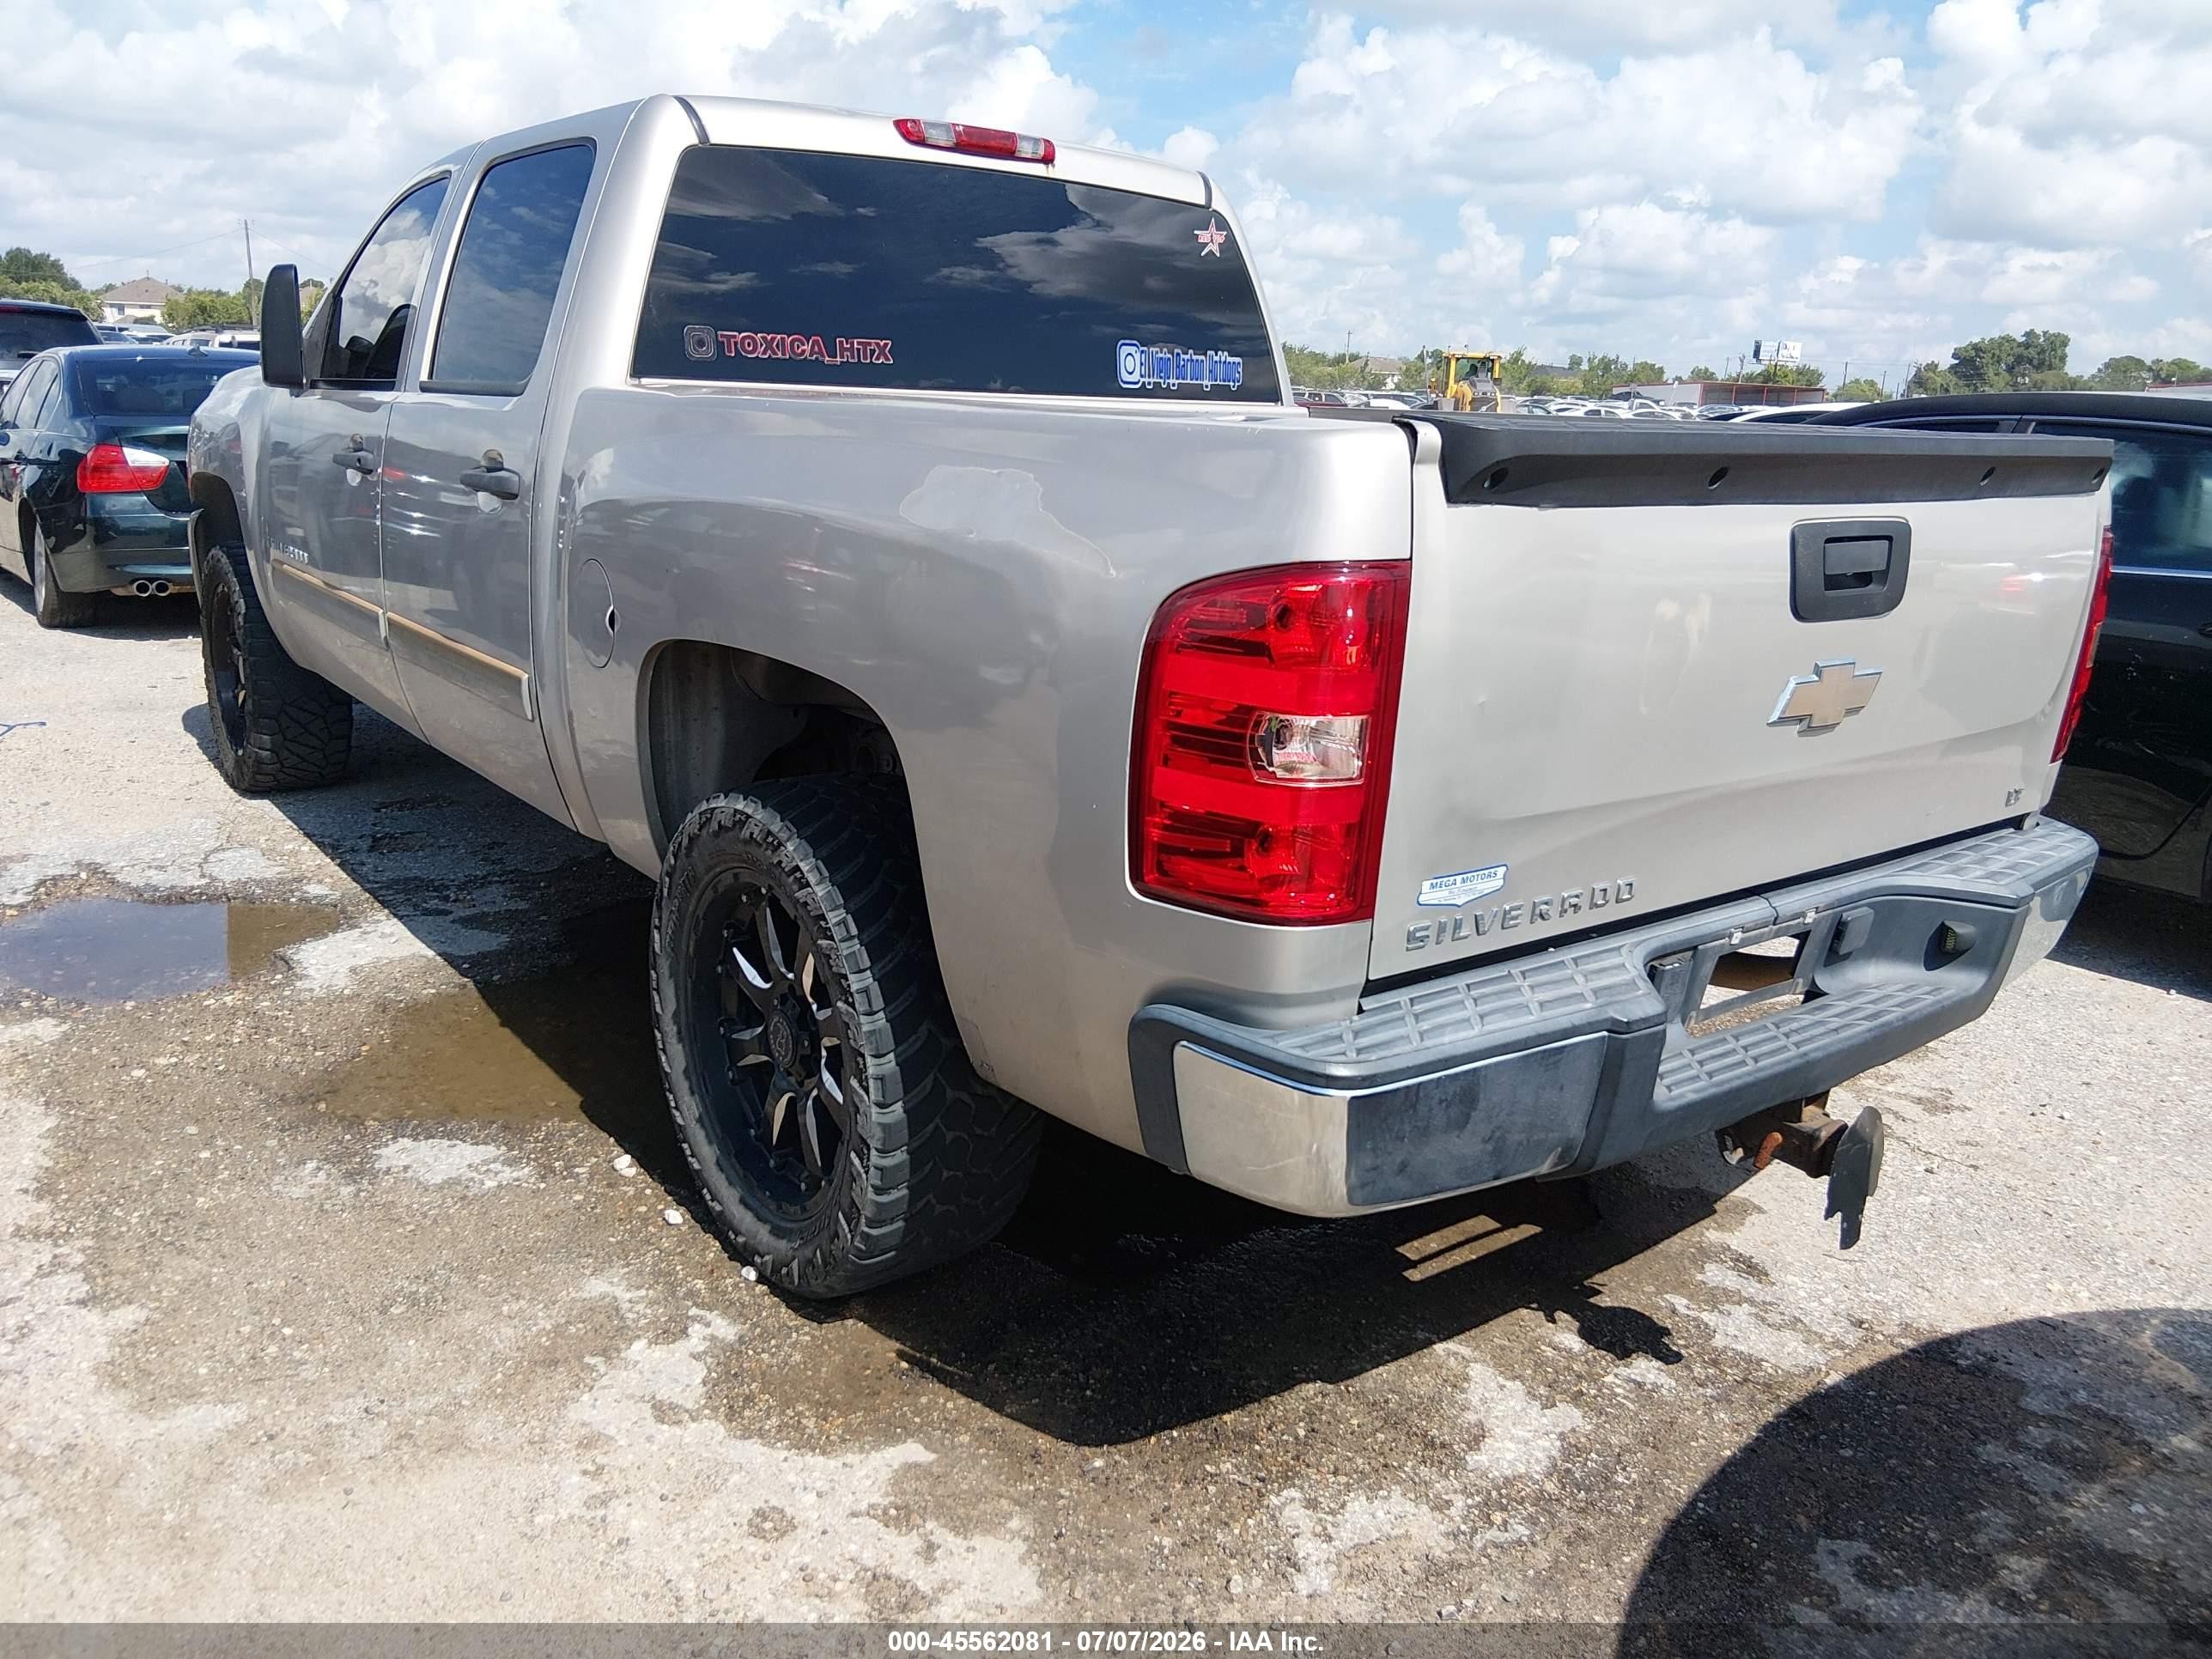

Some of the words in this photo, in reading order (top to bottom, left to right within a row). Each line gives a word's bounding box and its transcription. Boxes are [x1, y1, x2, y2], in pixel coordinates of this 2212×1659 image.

[718, 331, 894, 365] TOXICA_HTX
[1429, 878, 1457, 890] MEGA
[1460, 870, 1498, 885] MOTORS
[1406, 875, 1636, 952] SILVERADO
